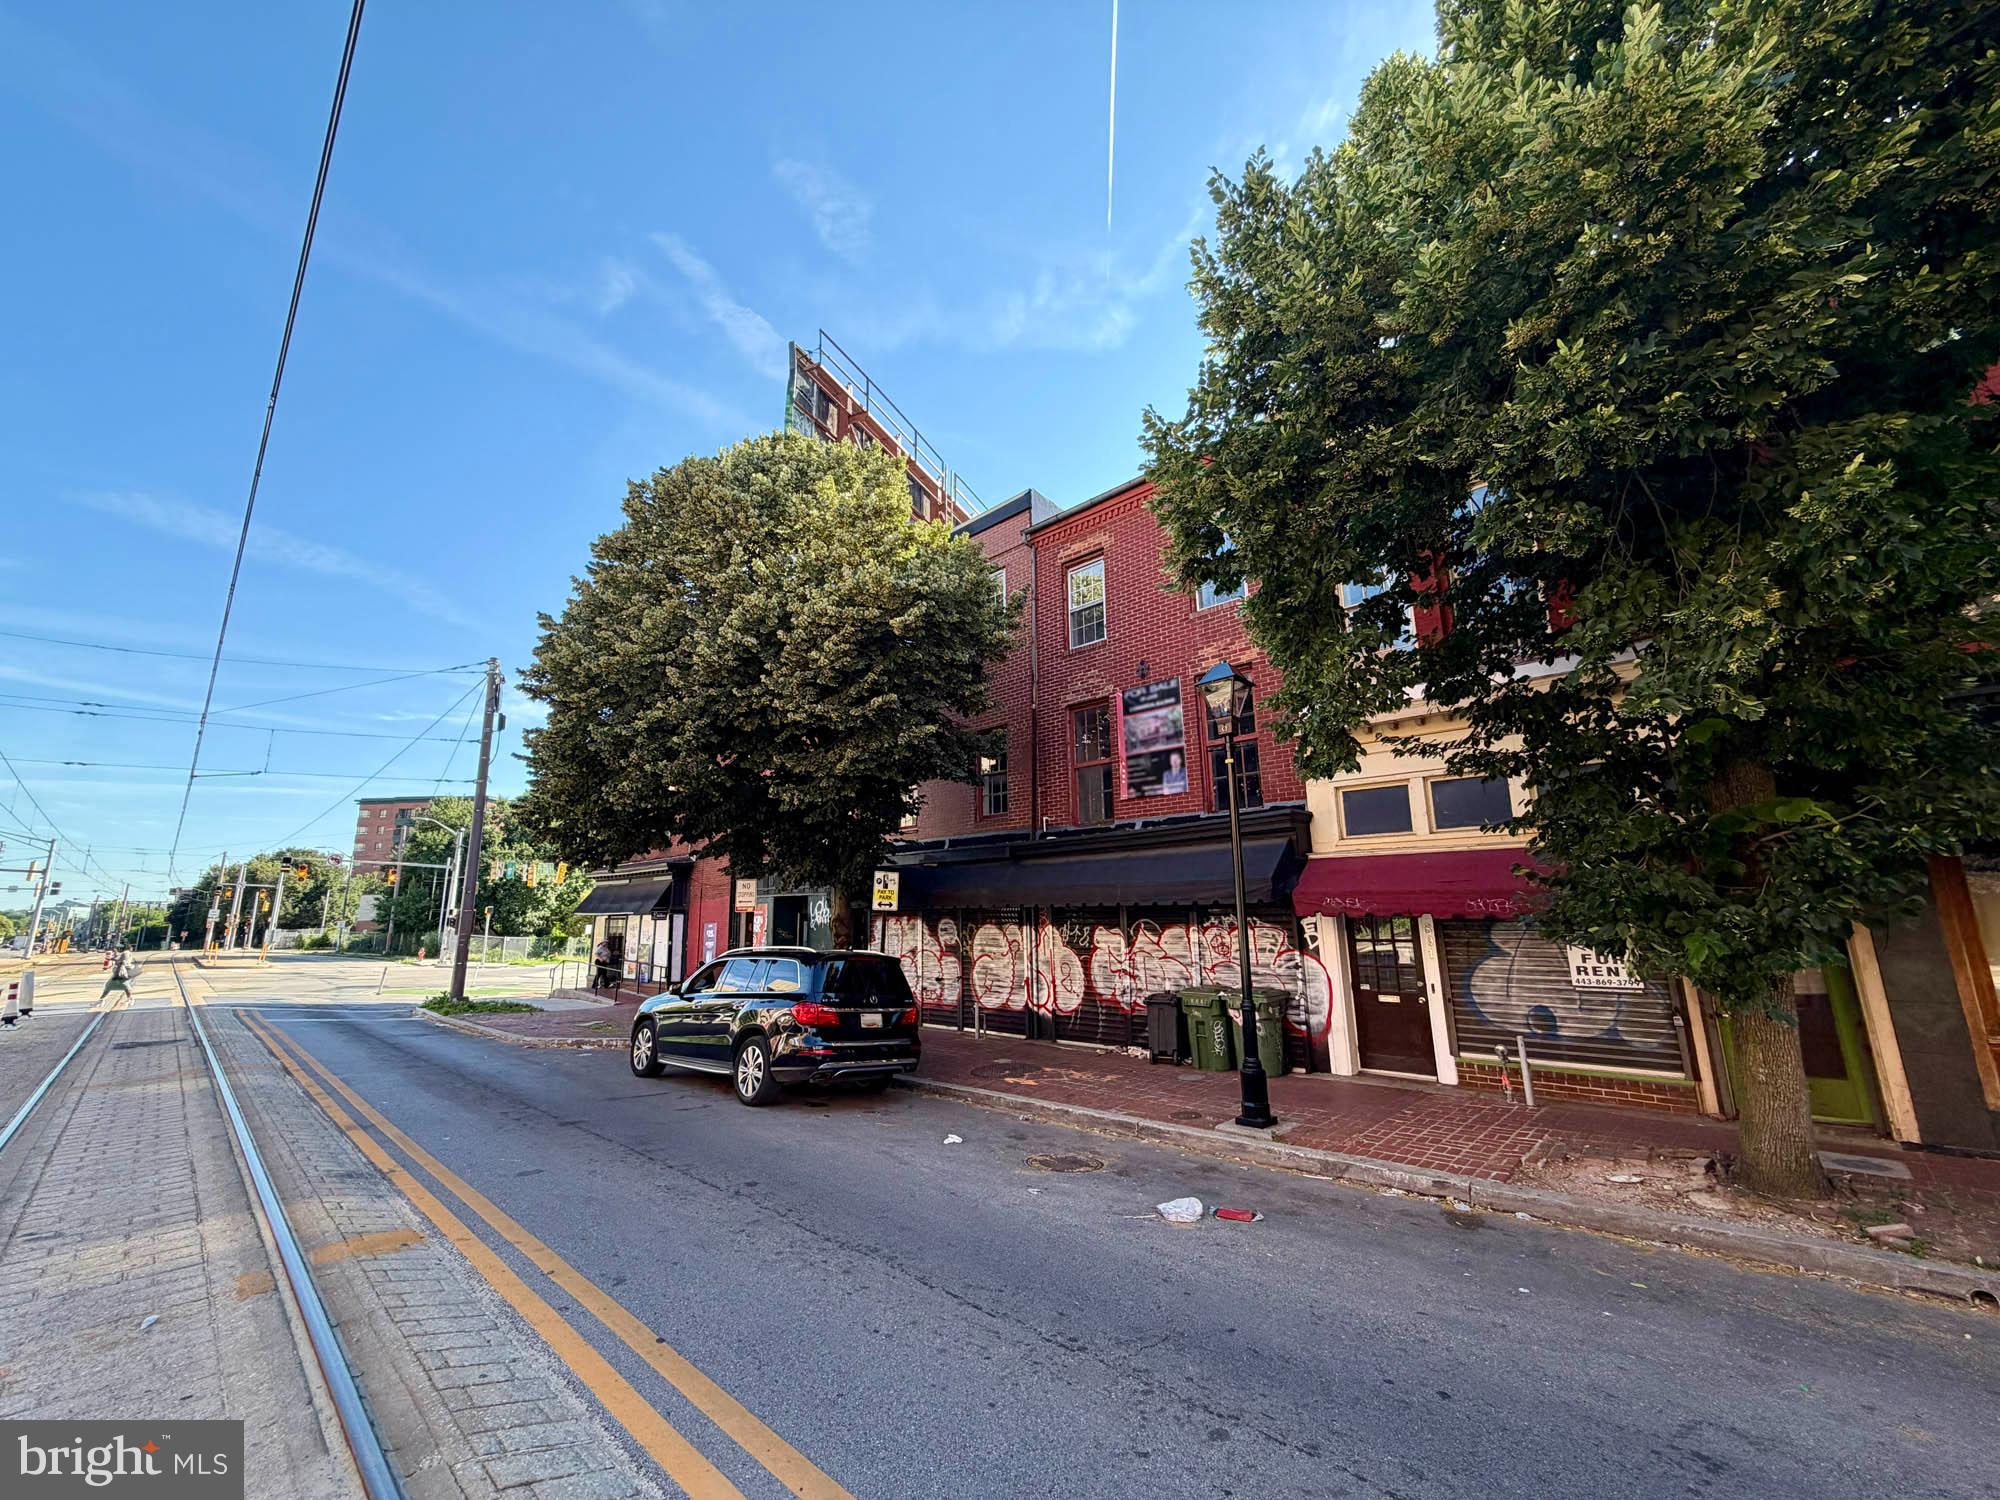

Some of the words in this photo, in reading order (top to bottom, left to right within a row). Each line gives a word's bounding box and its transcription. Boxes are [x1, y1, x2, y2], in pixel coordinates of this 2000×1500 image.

[1123, 687, 1147, 699] FOR
[1149, 679, 1178, 692] SALE
[742, 882, 751, 890] NO
[1581, 953, 1625, 965] FOR
[1576, 965, 1628, 977] REN
